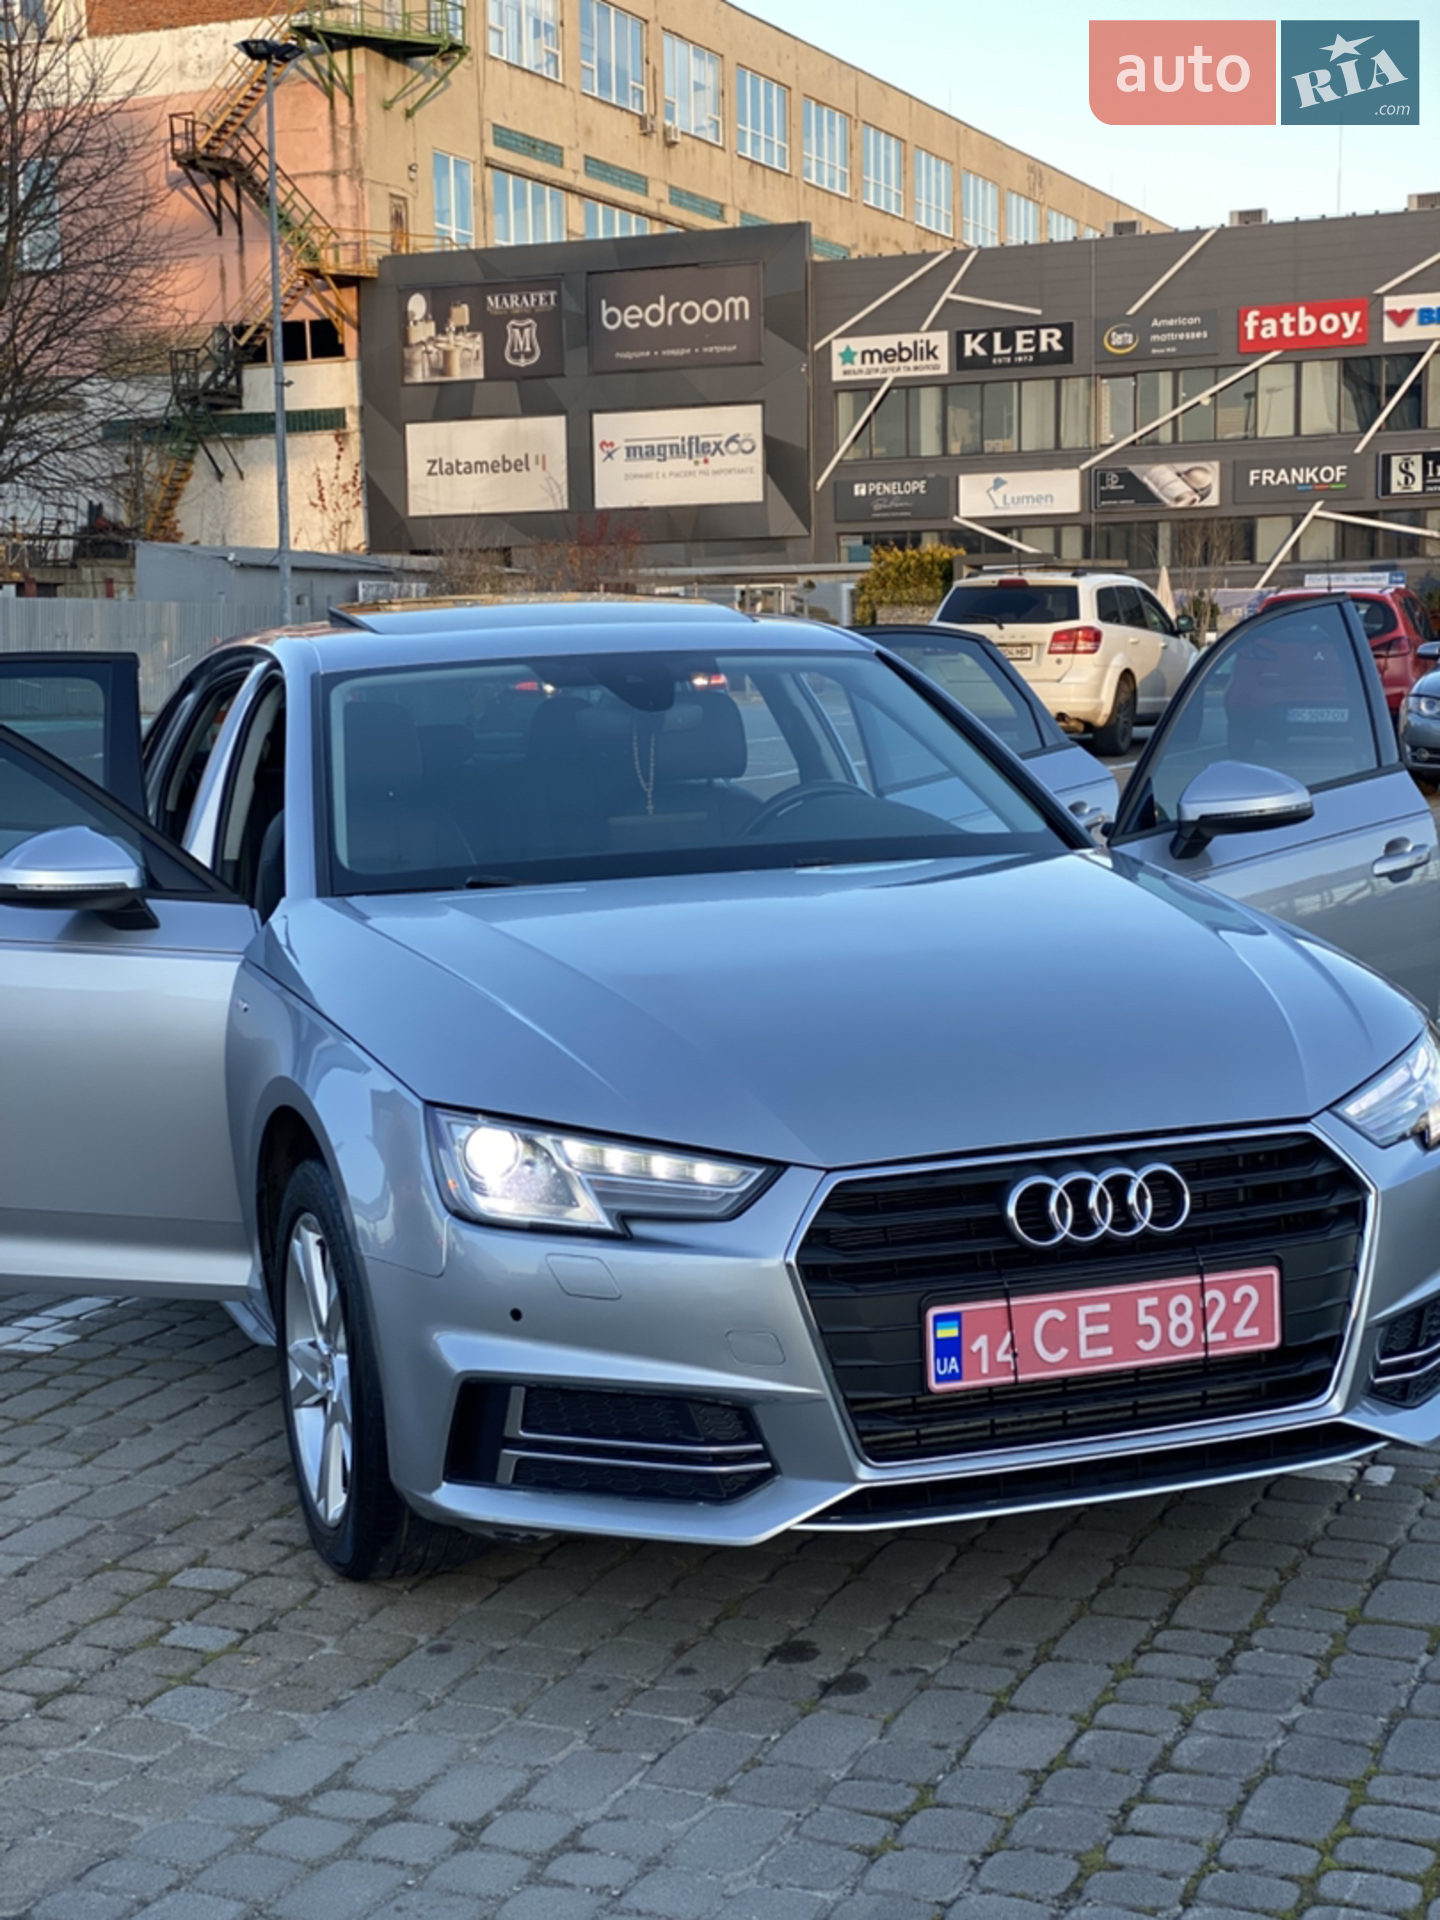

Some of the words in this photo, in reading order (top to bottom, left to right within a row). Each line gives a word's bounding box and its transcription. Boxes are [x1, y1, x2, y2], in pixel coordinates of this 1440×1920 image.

[486, 290, 558, 310] MARAFET
[601, 295, 750, 331] bedroom
[1151, 316, 1201, 328] American
[963, 327, 1064, 357] KLER
[1150, 330, 1208, 342] mattresses
[861, 339, 939, 364] meblik
[426, 452, 531, 477] Zlatamebel
[1249, 465, 1348, 486] FRANKOF
[868, 480, 927, 496] PENELOPE
[1002, 493, 1055, 506] Lumen
[969, 1331, 1017, 1375] 14
[1033, 1303, 1114, 1363] CE
[1135, 1284, 1260, 1352] 5822
[936, 1356, 960, 1376] UA
